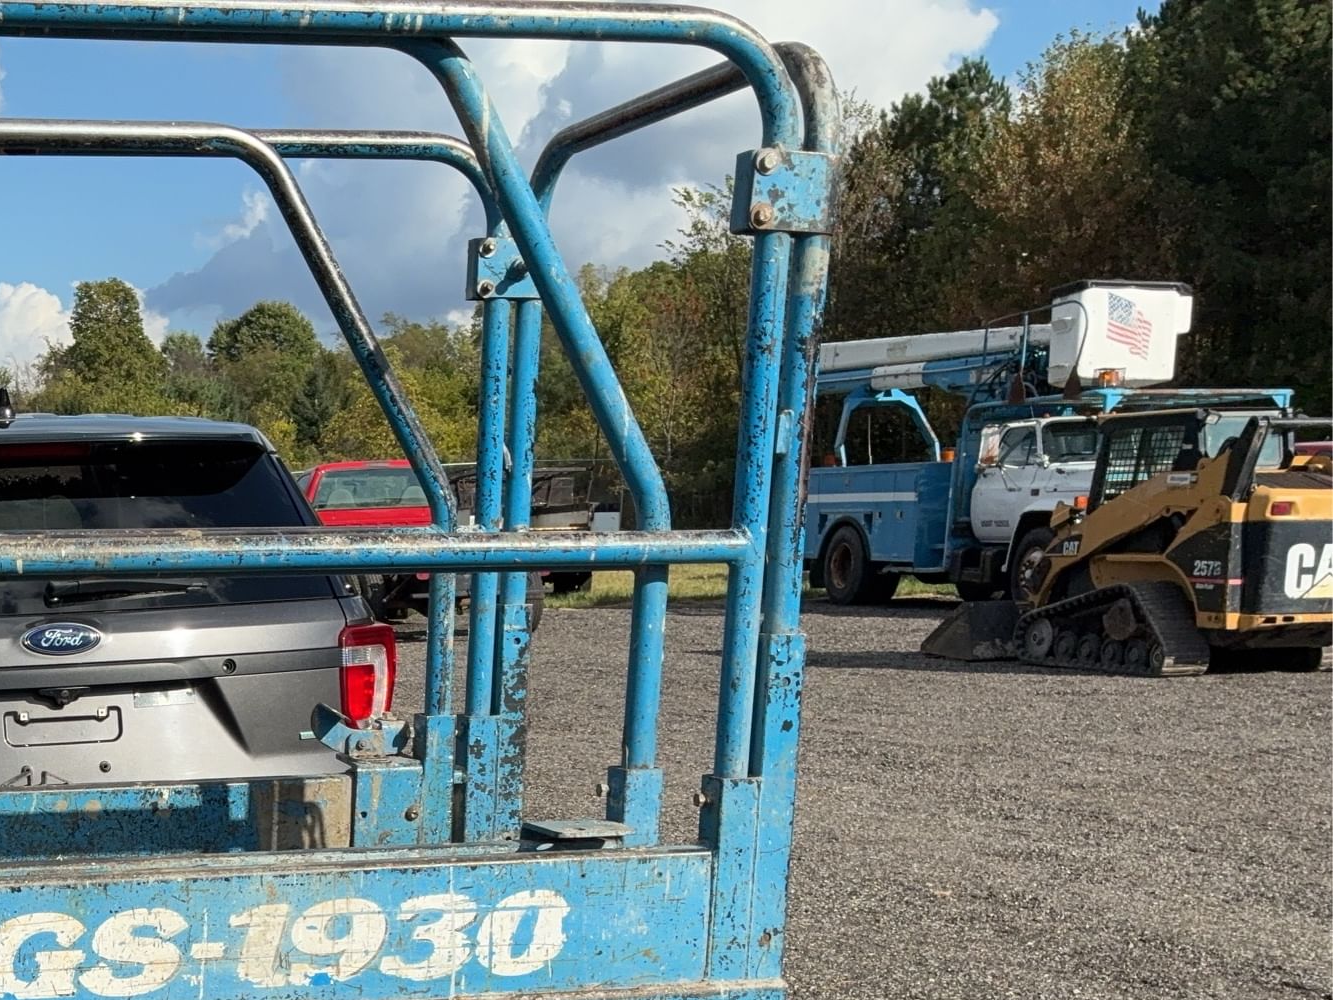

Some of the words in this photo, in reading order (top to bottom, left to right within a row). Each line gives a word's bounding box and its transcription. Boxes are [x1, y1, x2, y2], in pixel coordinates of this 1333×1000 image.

[1062, 541, 1080, 556] CAT
[1192, 560, 1222, 577] 257B
[1284, 543, 1333, 599] CA
[40, 628, 84, 647] Ford
